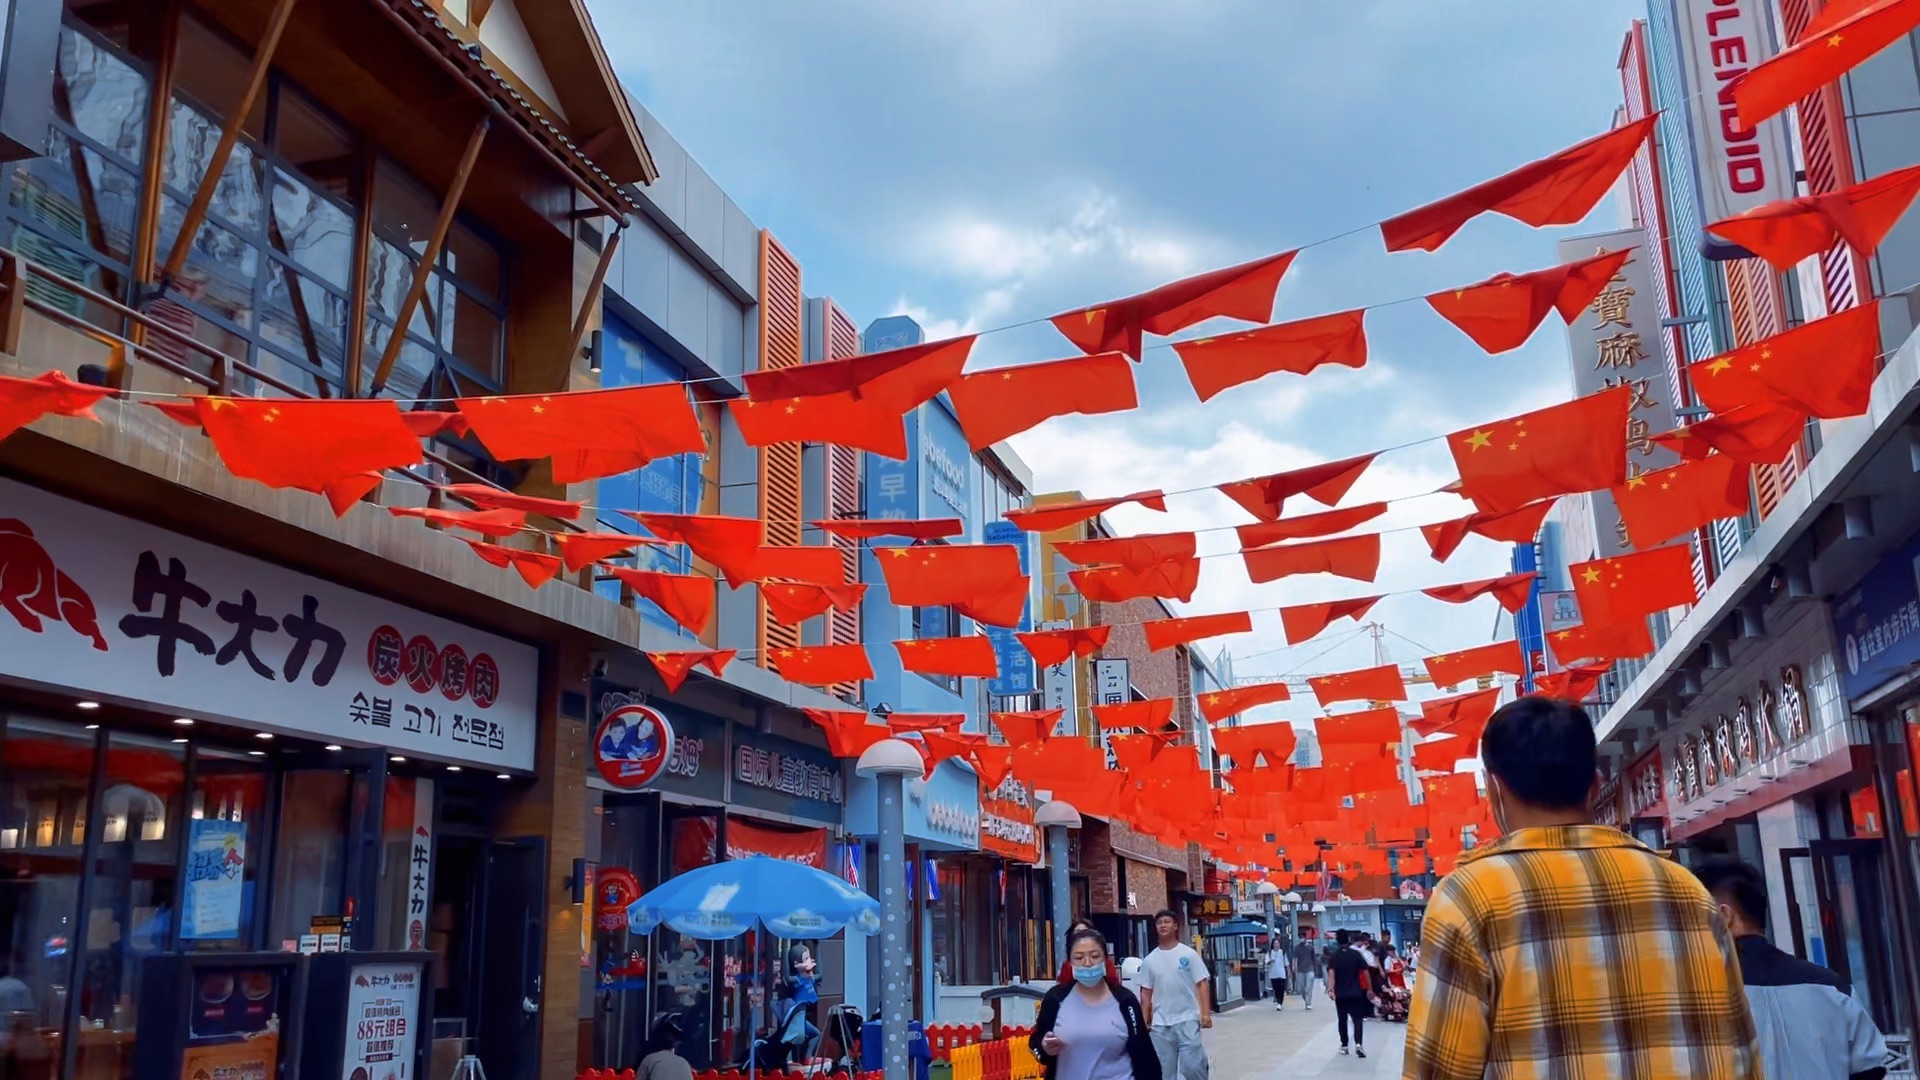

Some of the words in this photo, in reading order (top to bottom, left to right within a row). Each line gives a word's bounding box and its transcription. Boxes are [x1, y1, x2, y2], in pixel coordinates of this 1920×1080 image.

[1706, 0, 1765, 193] LENDID
[119, 550, 346, 686] 牛大力
[369, 629, 498, 705] 炭火烤肉
[349, 691, 392, 728] 숯불
[403, 703, 441, 737] 고기
[452, 714, 504, 751] 전문점
[738, 744, 843, 804] 国际儿童教育中心
[411, 845, 428, 914] 牛大力
[357, 1018, 406, 1040] 88元组合
